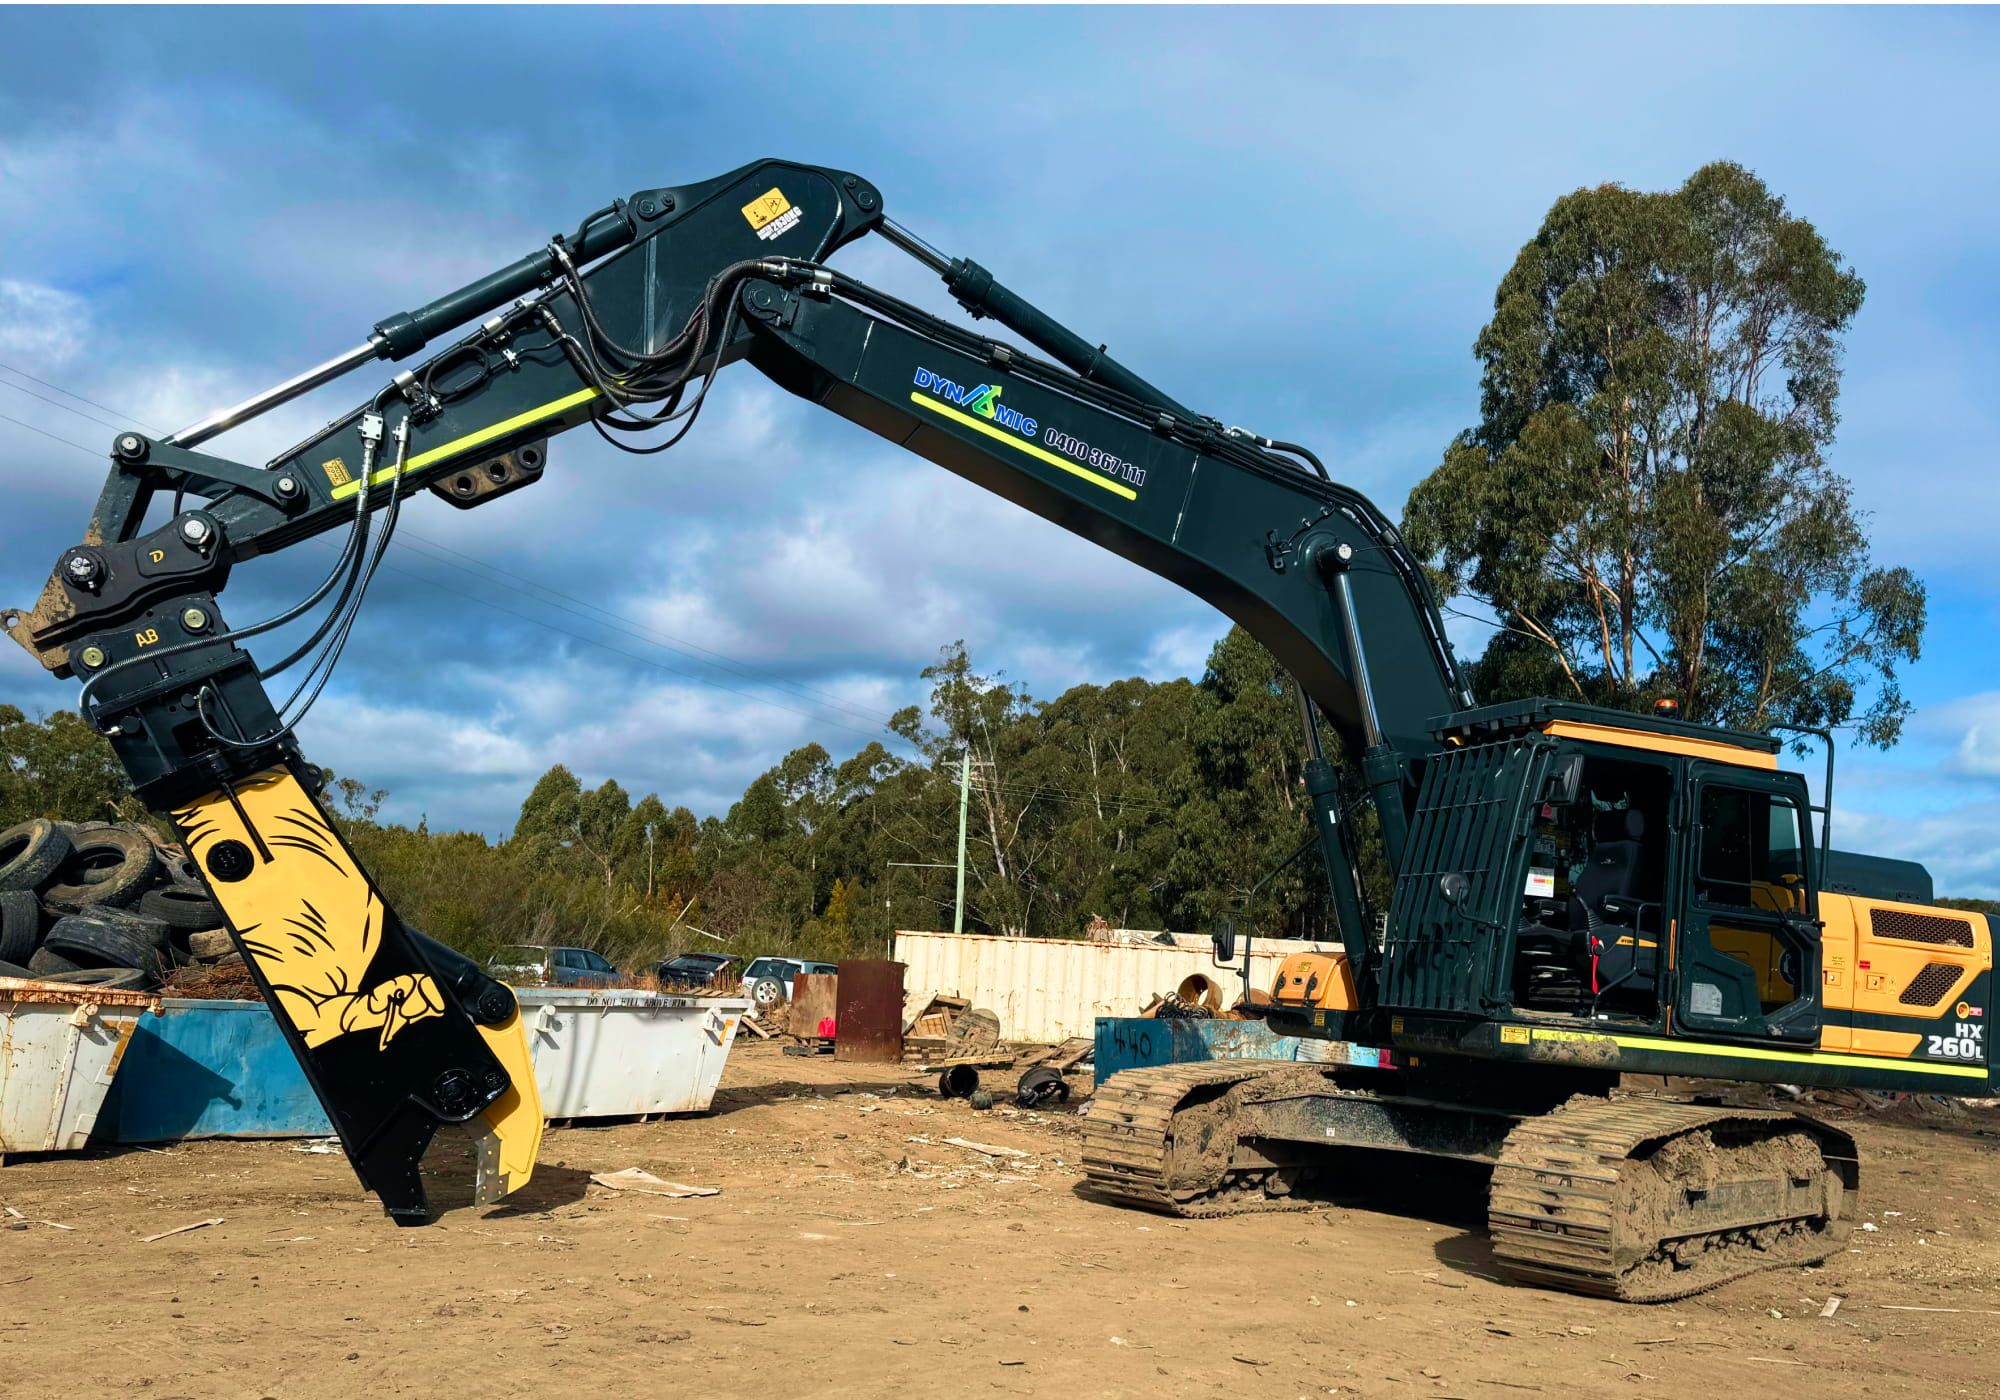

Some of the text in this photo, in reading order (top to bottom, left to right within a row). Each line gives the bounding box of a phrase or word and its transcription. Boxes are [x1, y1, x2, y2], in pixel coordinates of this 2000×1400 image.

[913, 366, 1146, 487] DYNAMIC 0400 367 111
[602, 998, 616, 1007] NOT
[1955, 1022, 1984, 1039] HX
[1928, 1035, 1984, 1060] 260L
